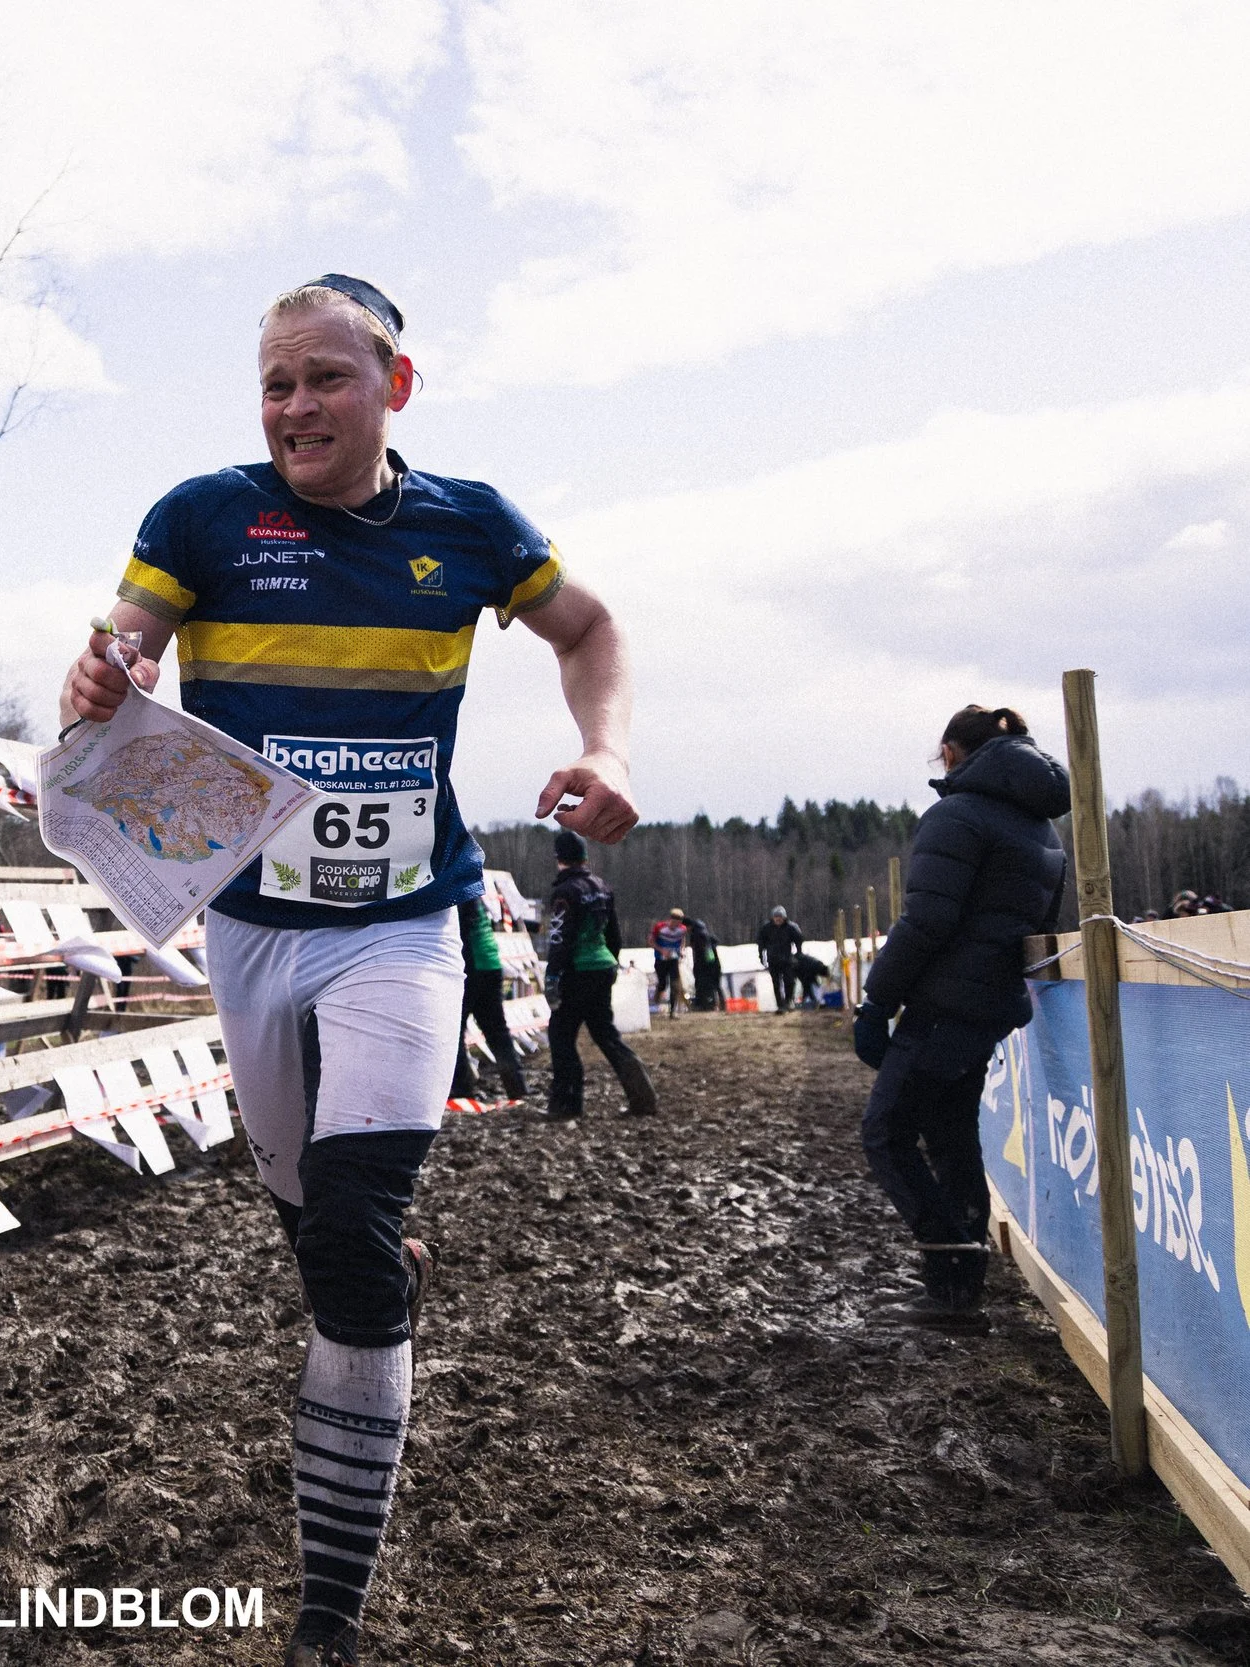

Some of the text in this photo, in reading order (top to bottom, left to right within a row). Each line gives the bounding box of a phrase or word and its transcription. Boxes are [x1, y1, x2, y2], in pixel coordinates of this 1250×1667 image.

[258, 511, 295, 527] ICA
[250, 528, 306, 539] KVANTUM
[233, 551, 315, 567] JUNET
[416, 563, 428, 572] IK
[250, 577, 309, 591] TRIMTEX
[269, 742, 432, 775] bagheera
[374, 781, 388, 790] STL
[389, 781, 399, 789] #1
[401, 779, 420, 788] 2026
[313, 802, 390, 849] 65
[413, 798, 426, 816] 3
[317, 864, 382, 875] GODKÄNDA
